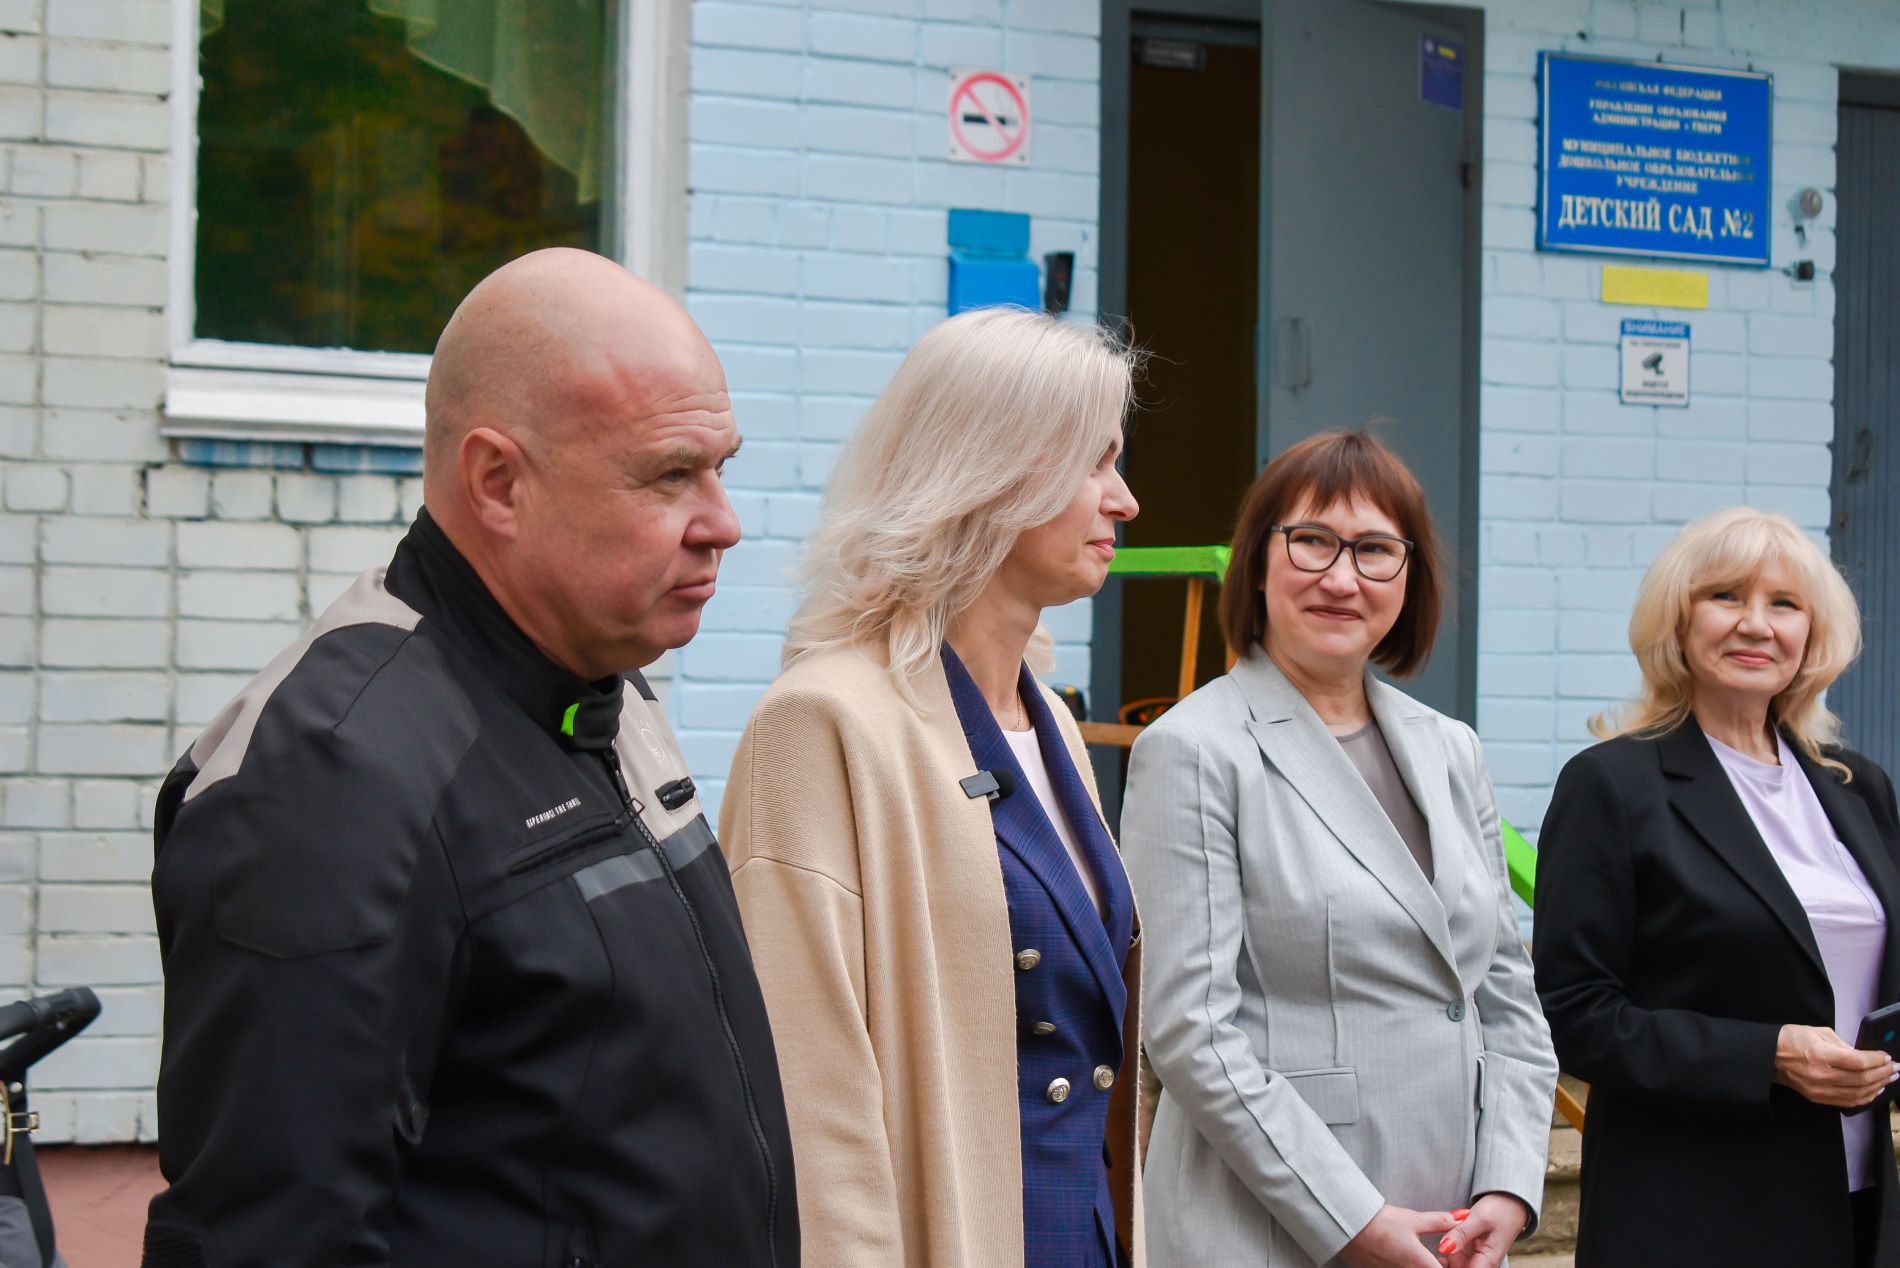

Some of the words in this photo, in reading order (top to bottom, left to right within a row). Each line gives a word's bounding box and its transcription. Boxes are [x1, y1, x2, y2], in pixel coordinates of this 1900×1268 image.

[1562, 138, 1672, 160] МУНИЦИПАЛЬНОЕ
[1558, 154, 1641, 173] ДОШКОЛЬНОЕ
[1616, 175, 1699, 194] УЧРЕЖДЕНИЕ
[1558, 194, 1661, 232] ДЕТСКИЙ
[1668, 203, 1713, 240] САД
[1720, 208, 1755, 239] №2
